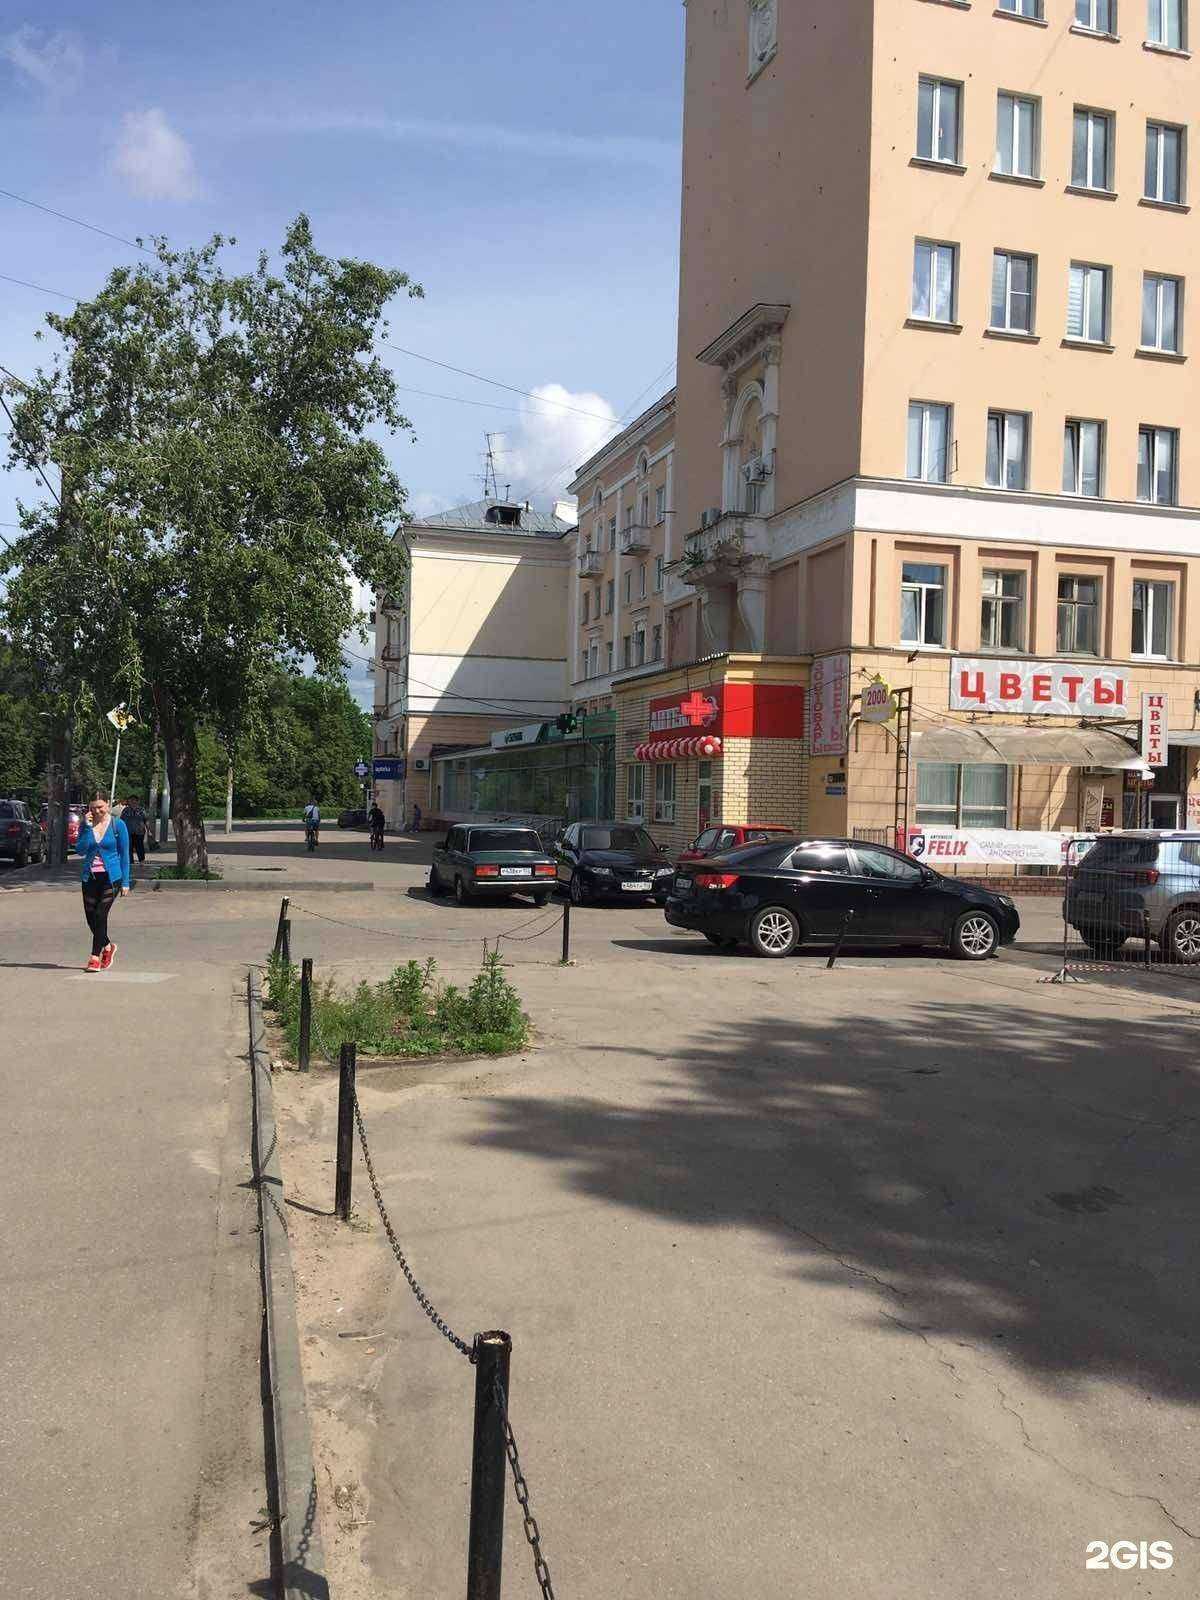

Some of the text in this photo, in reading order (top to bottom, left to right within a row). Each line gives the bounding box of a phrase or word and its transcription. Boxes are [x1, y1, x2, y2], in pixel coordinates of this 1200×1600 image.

[867, 688, 887, 706] 2000
[960, 671, 1124, 705] ЦВЕТЫ
[1147, 696, 1164, 763] ЦВЕТЫ
[927, 840, 969, 856] FELIX
